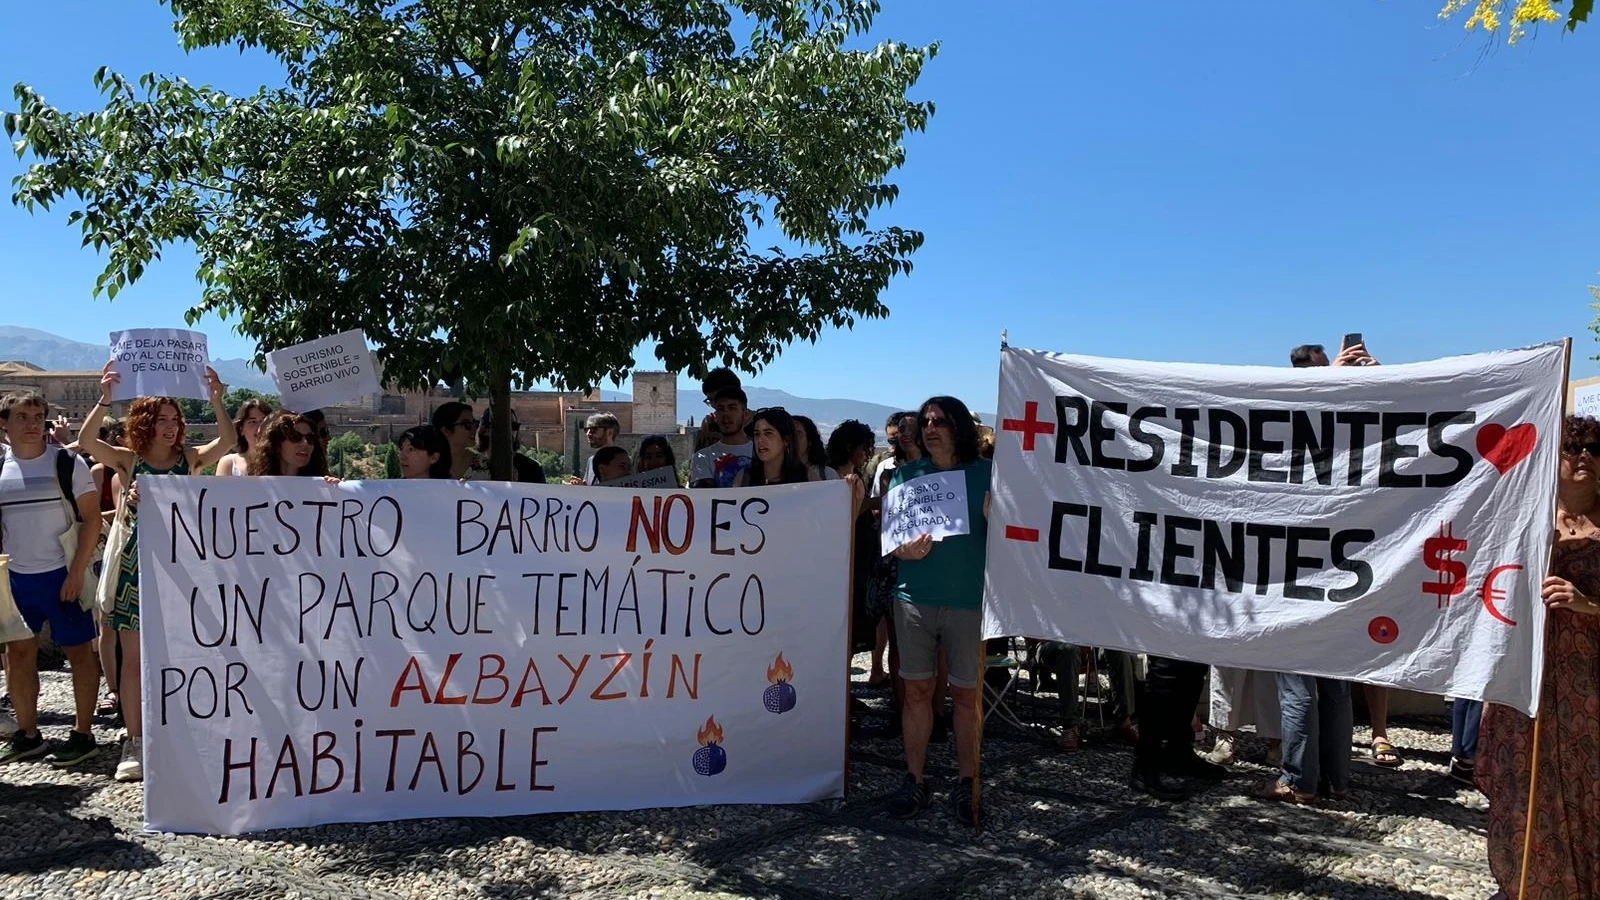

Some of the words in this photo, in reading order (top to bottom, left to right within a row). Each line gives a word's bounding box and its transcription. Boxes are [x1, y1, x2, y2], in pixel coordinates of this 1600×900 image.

[117, 351, 139, 362] VOY
[140, 351, 154, 360] AL
[156, 350, 203, 363] CENTRO
[135, 338, 165, 349] DEJA
[167, 338, 207, 351] PASAR?
[293, 344, 344, 366] TURISMO
[131, 362, 147, 373] DE
[149, 362, 188, 373] SALUD
[283, 354, 352, 381] SOSTENIBLE
[290, 373, 333, 393] BARRIO
[334, 365, 360, 380] VIVO
[1054, 396, 1477, 489] RESIDENTES
[946, 491, 955, 500] O
[171, 488, 402, 563] NUESTRO
[625, 493, 695, 555] NO
[710, 497, 770, 556] ES
[1048, 500, 1376, 602] CLIENTES
[1422, 520, 1468, 609] $
[1476, 564, 1524, 627] €
[190, 577, 270, 648] UN
[298, 571, 496, 644] PARQUE
[161, 661, 254, 726] POR
[296, 656, 365, 712] UN
[390, 638, 702, 708] ALBAYZÍN
